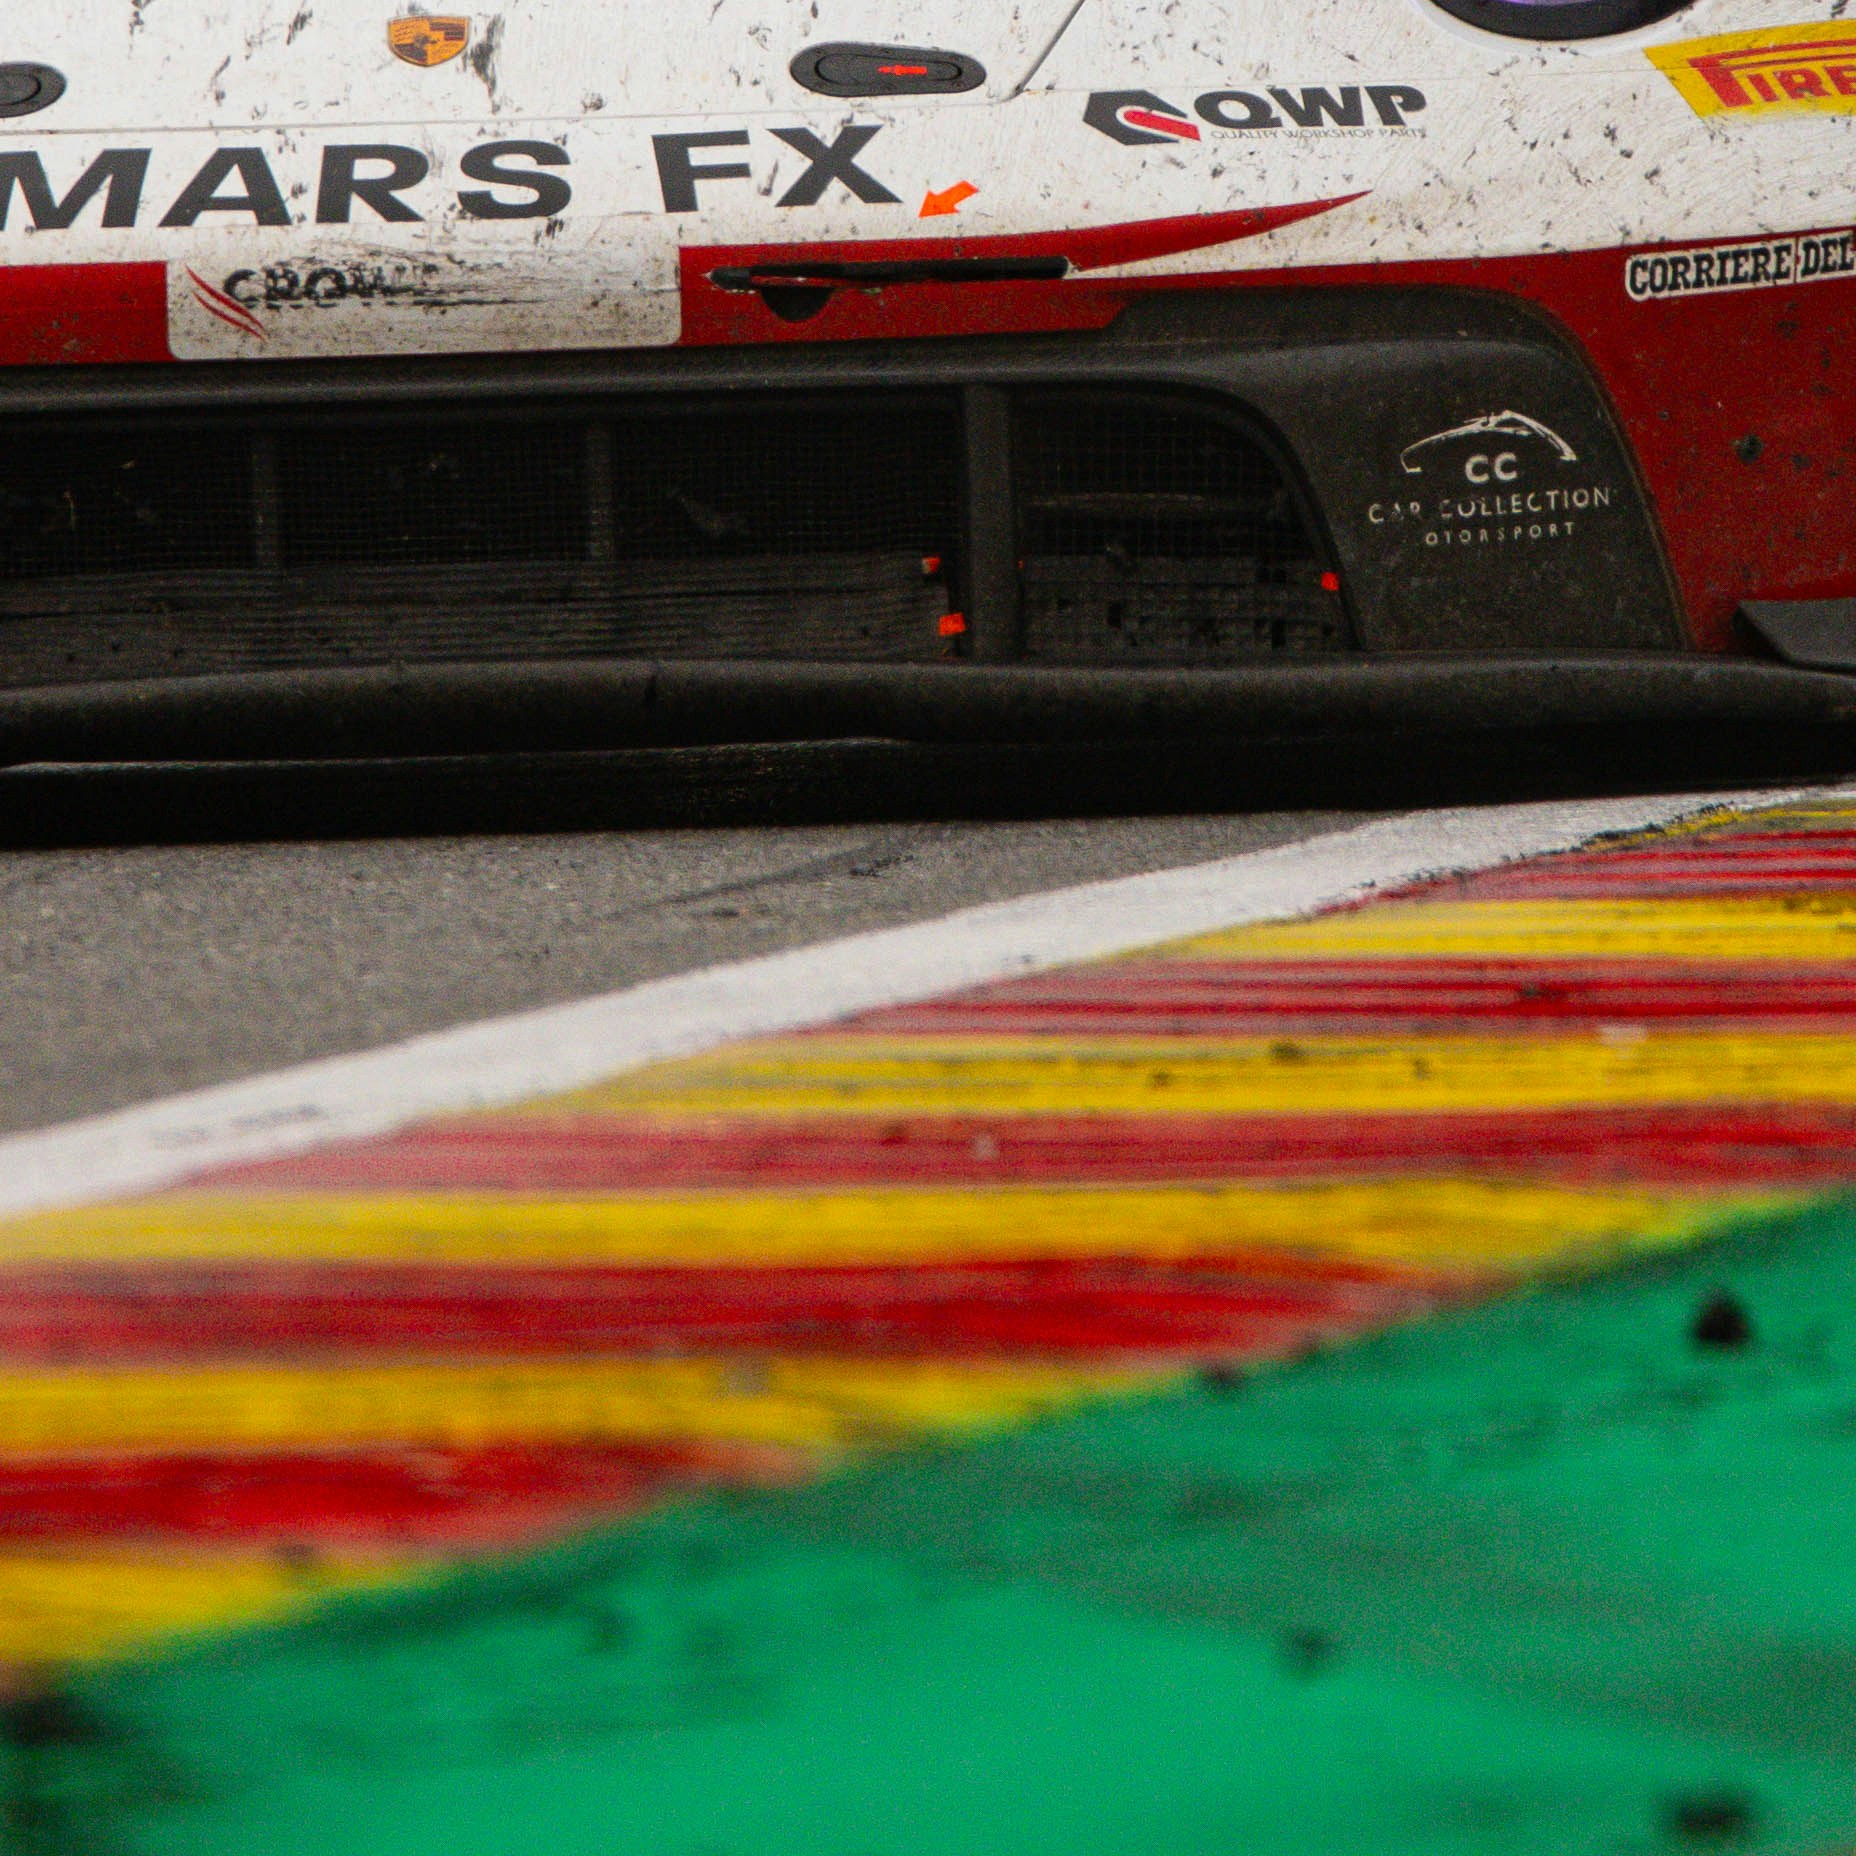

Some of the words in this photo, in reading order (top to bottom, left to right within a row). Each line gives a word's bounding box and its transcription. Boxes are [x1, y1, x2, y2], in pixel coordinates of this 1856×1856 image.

[1193, 85, 1428, 128] QWP
[1210, 129, 1279, 141] QUALITY
[1283, 128, 1375, 141] WORKSHOP
[1379, 127, 1427, 139] PARTS
[651, 123, 904, 213] FX
[1629, 242, 1792, 297] CORRIERE
[1800, 232, 1856, 276] DEL
[1465, 451, 1518, 484] CC
[1441, 486, 1611, 519] COLLECTION
